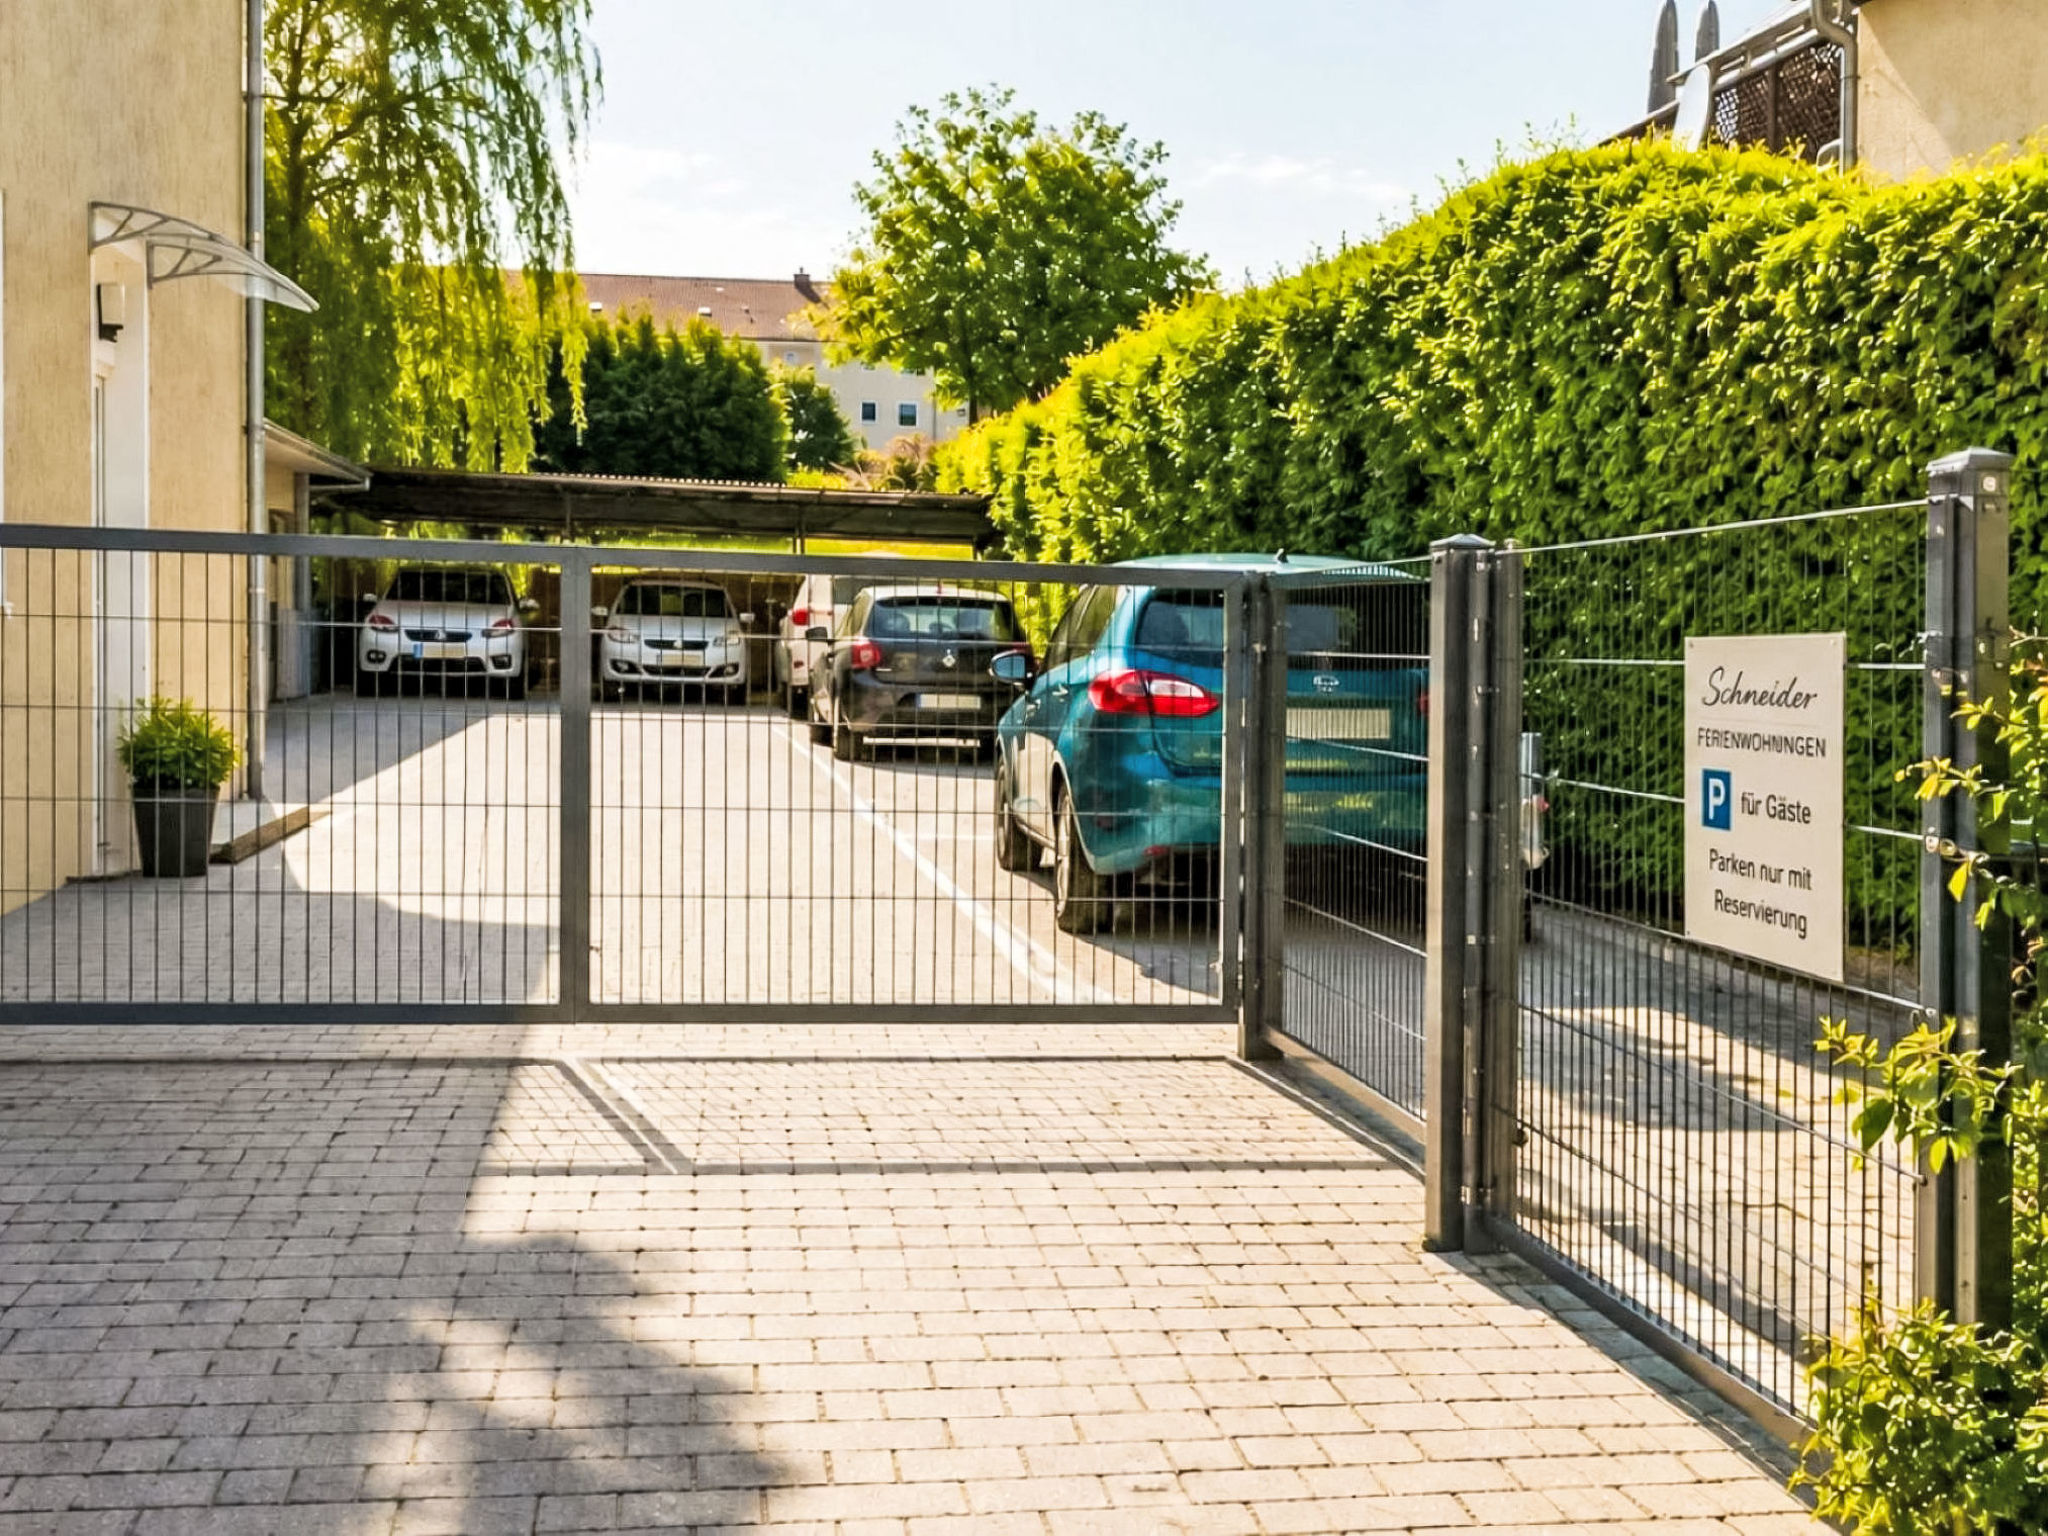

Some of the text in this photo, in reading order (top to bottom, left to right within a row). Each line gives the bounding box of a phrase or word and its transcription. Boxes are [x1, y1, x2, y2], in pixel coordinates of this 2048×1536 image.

[1701, 665, 1818, 710] Schneider
[1697, 727, 1826, 758] FERIENWOHNUNGEN
[1708, 778, 1812, 825] P für Gäste
[1709, 848, 1813, 891] Parken nur mit
[1714, 888, 1808, 941] Reservierung
